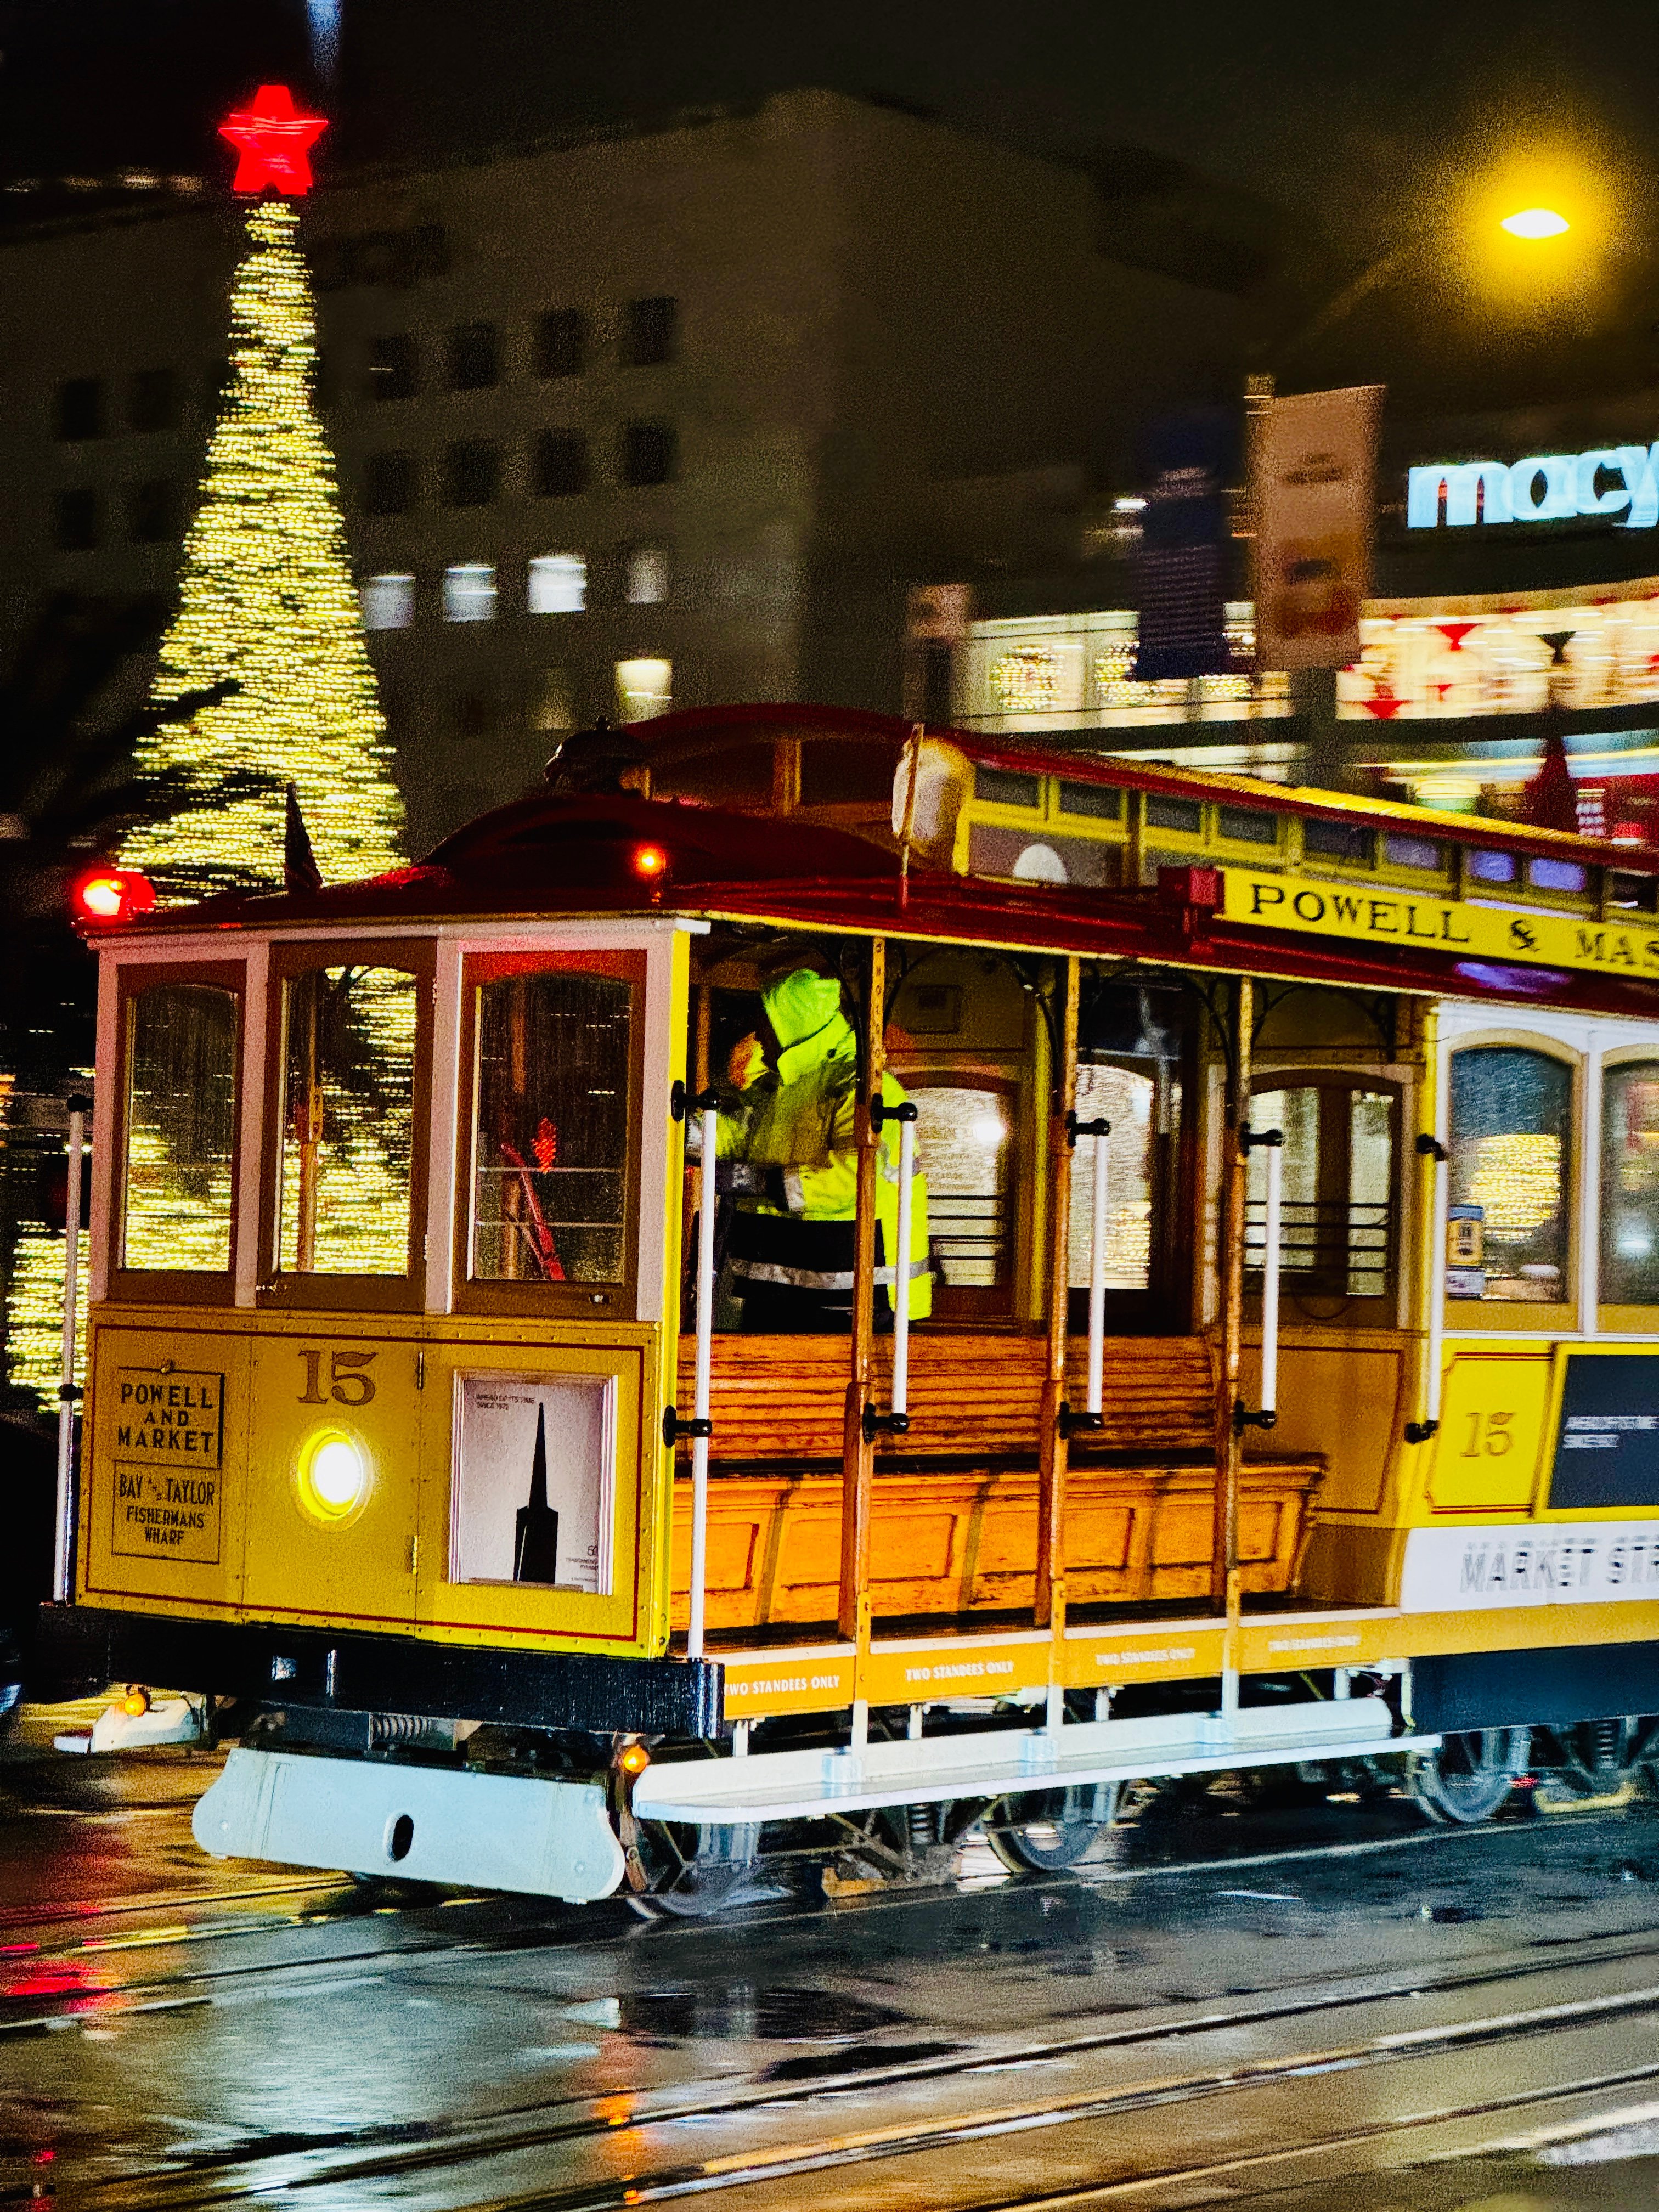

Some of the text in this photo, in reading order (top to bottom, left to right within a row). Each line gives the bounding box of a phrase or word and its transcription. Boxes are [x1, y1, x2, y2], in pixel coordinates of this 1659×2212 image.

[1249, 883, 1470, 943] POWELL
[1508, 919, 1541, 953] &
[296, 1350, 378, 1406] 15
[120, 1382, 214, 1409] POWELL
[143, 1409, 190, 1427] AND
[117, 1426, 215, 1454] MARKET
[1460, 1412, 1517, 1458] 15
[119, 1473, 143, 1499] BAY
[166, 1477, 216, 1507] TAYLOR
[126, 1505, 205, 1529] FISHERMANS
[144, 1526, 185, 1545] WHARF
[1459, 1539, 1599, 1592] MARKET
[905, 1660, 1015, 1682] TWO STANDEES ONLY
[724, 1675, 840, 1697] TWO STANDEES ONLY
